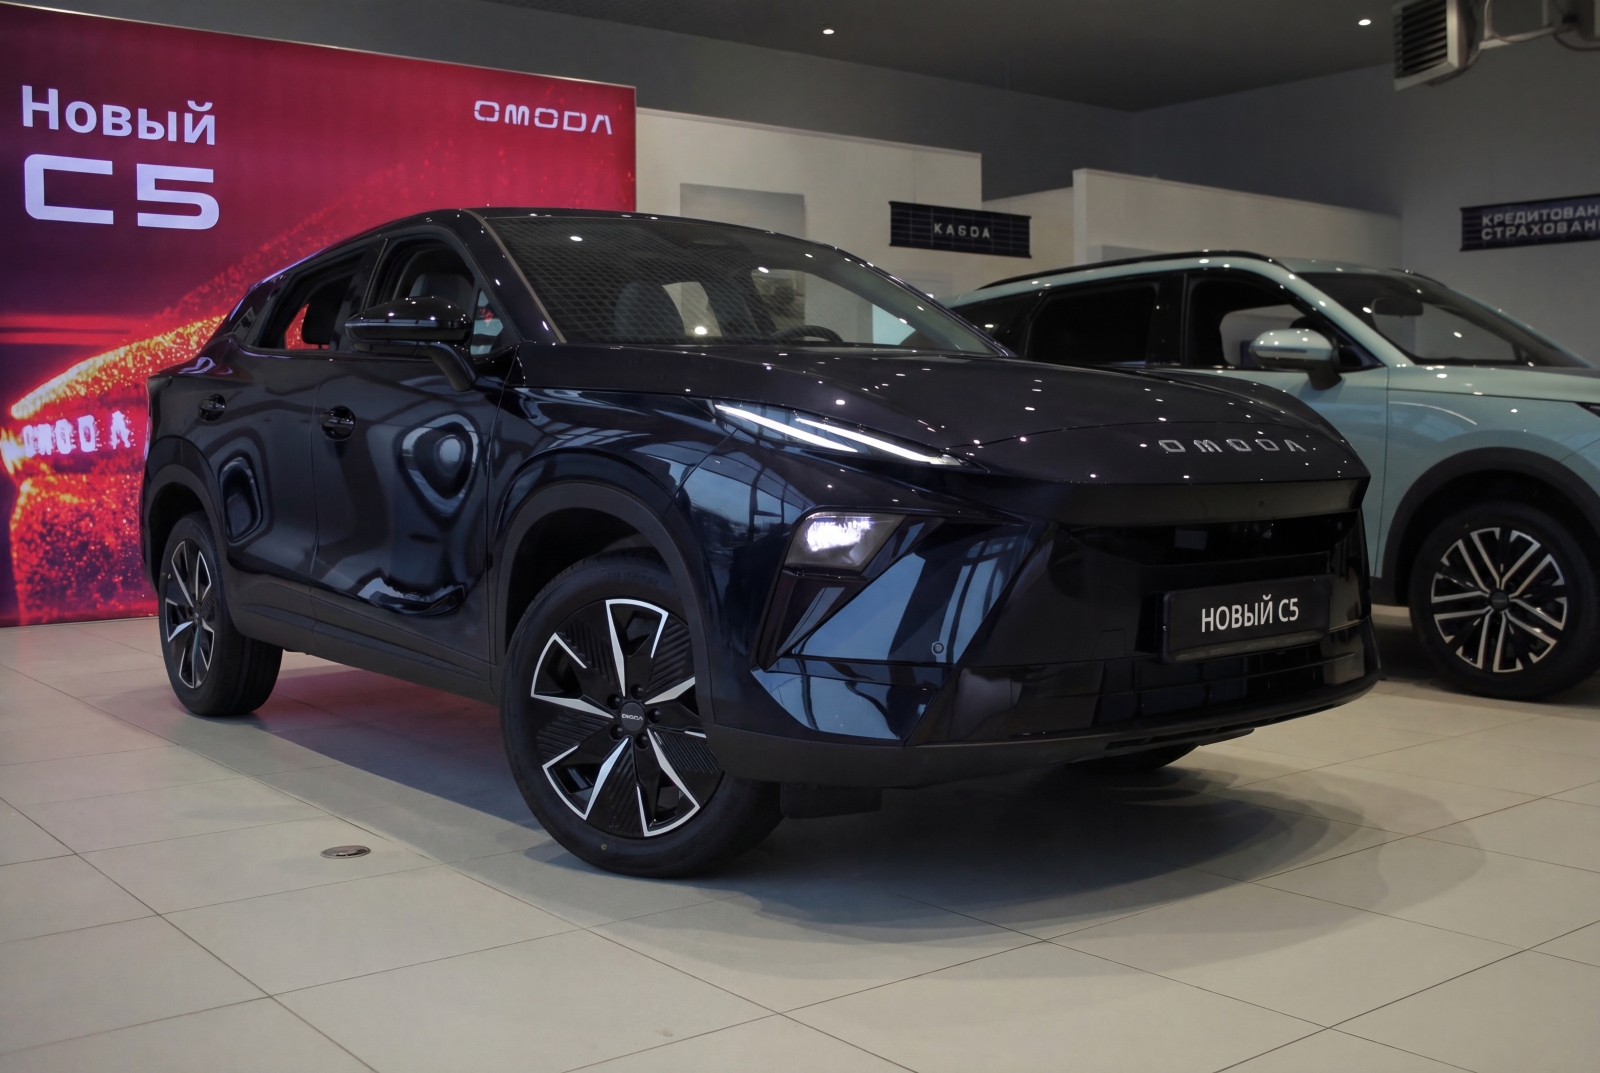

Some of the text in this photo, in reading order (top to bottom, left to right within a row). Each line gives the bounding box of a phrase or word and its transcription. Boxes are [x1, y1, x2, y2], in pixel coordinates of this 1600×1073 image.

[22, 85, 215, 146] Новый
[474, 100, 612, 135] OMODA
[24, 153, 220, 230] C5
[1481, 218, 1600, 240] СТРАХОВАН
[1158, 438, 1308, 453] OMODA
[1201, 593, 1299, 632] НОВЫЙ C5
